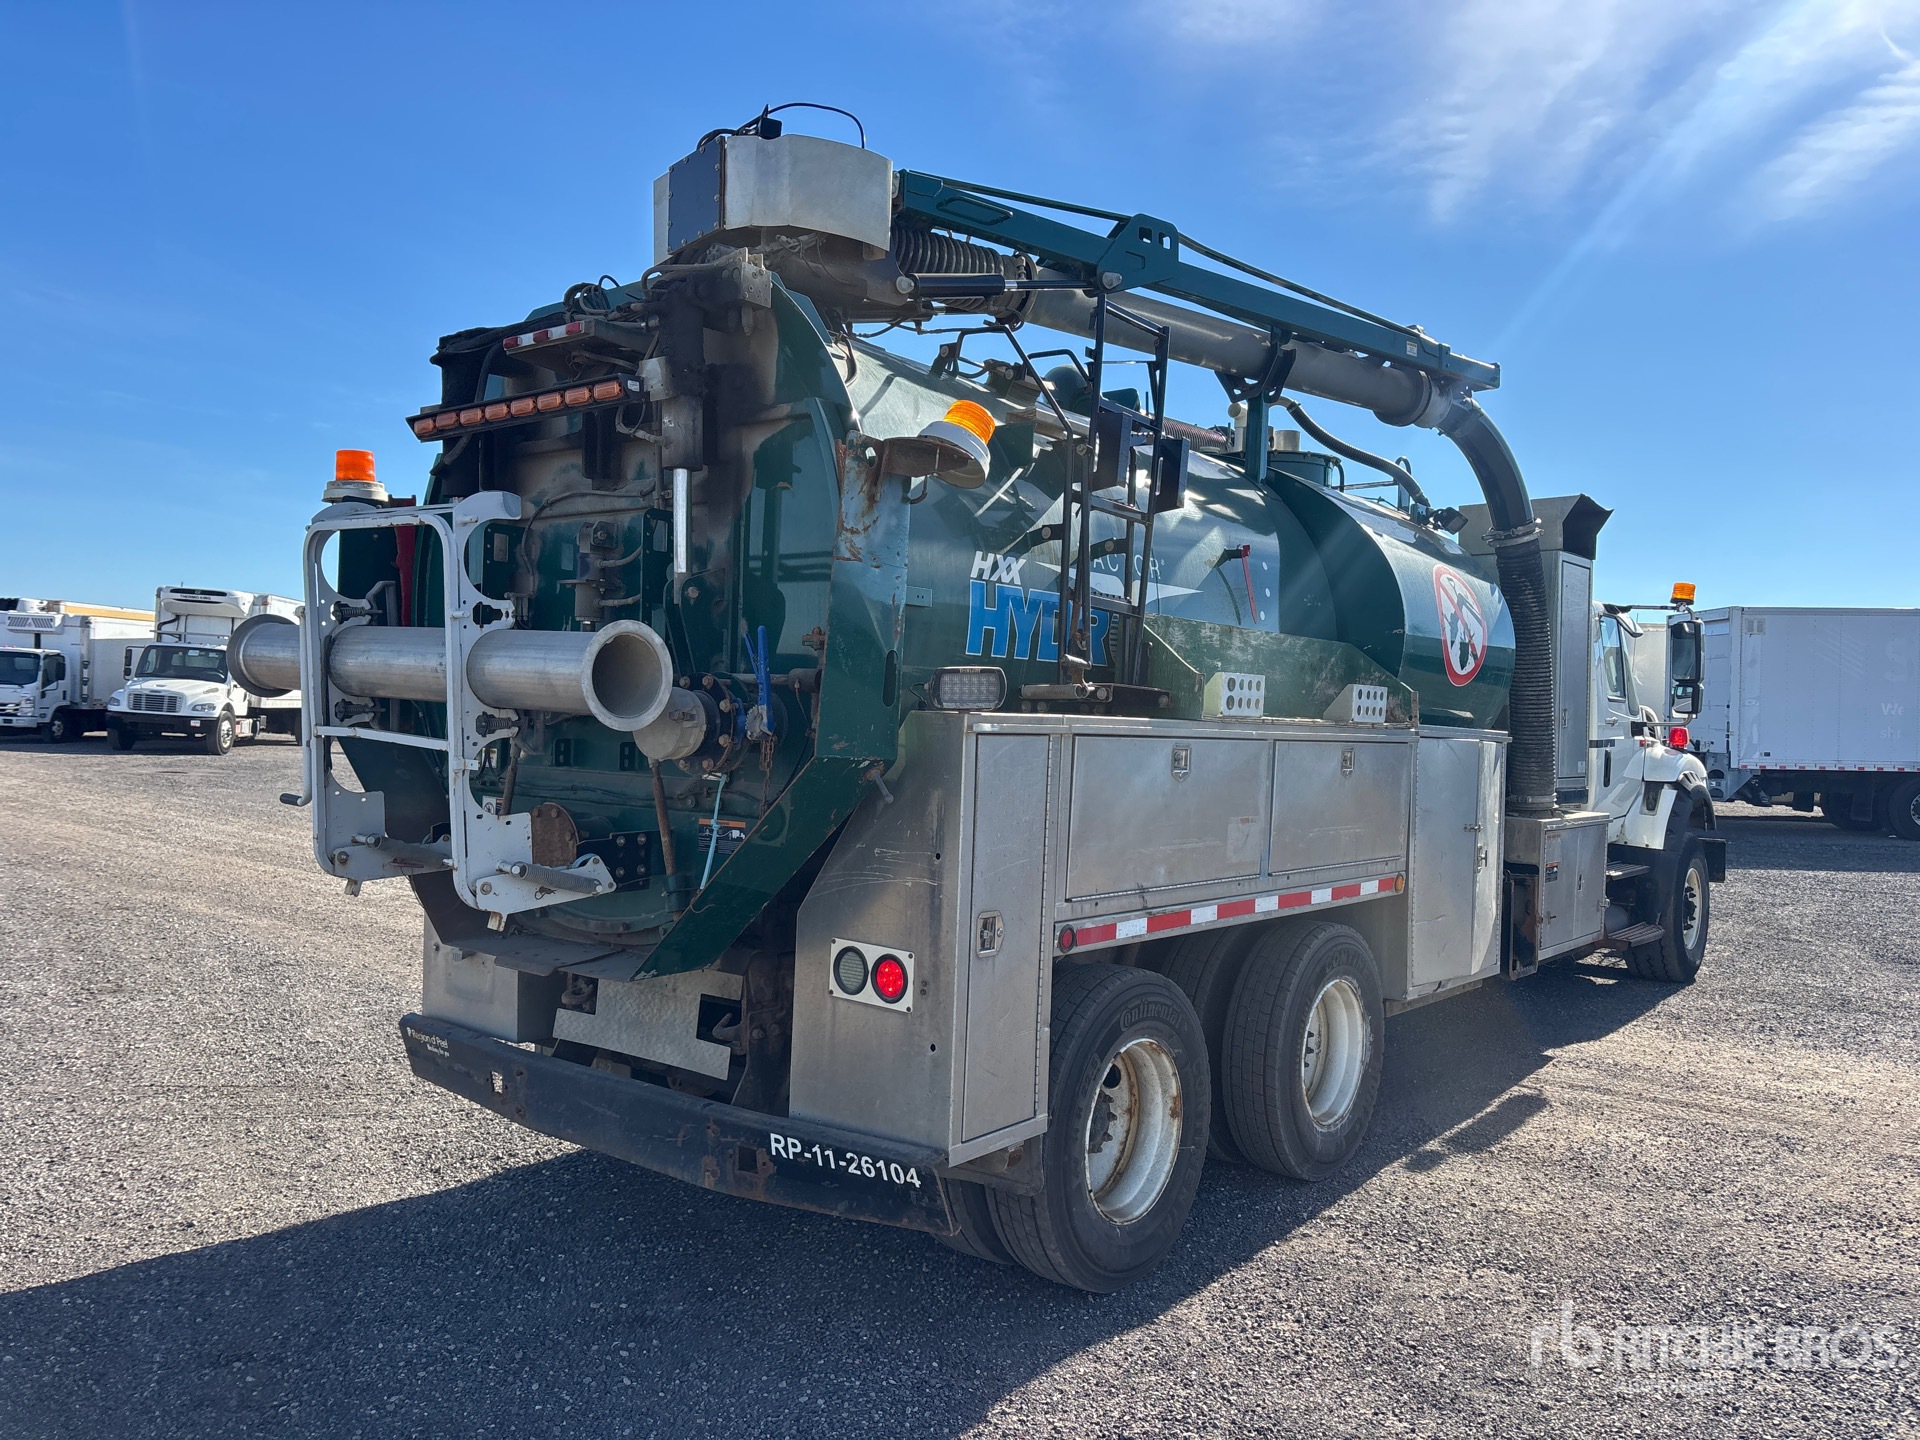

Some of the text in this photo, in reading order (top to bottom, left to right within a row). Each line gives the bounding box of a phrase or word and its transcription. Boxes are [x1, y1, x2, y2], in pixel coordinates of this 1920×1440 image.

[970, 551, 1027, 585] HXX
[1120, 999, 1181, 1032] Continental
[769, 1132, 922, 1188] RP-11-26104
